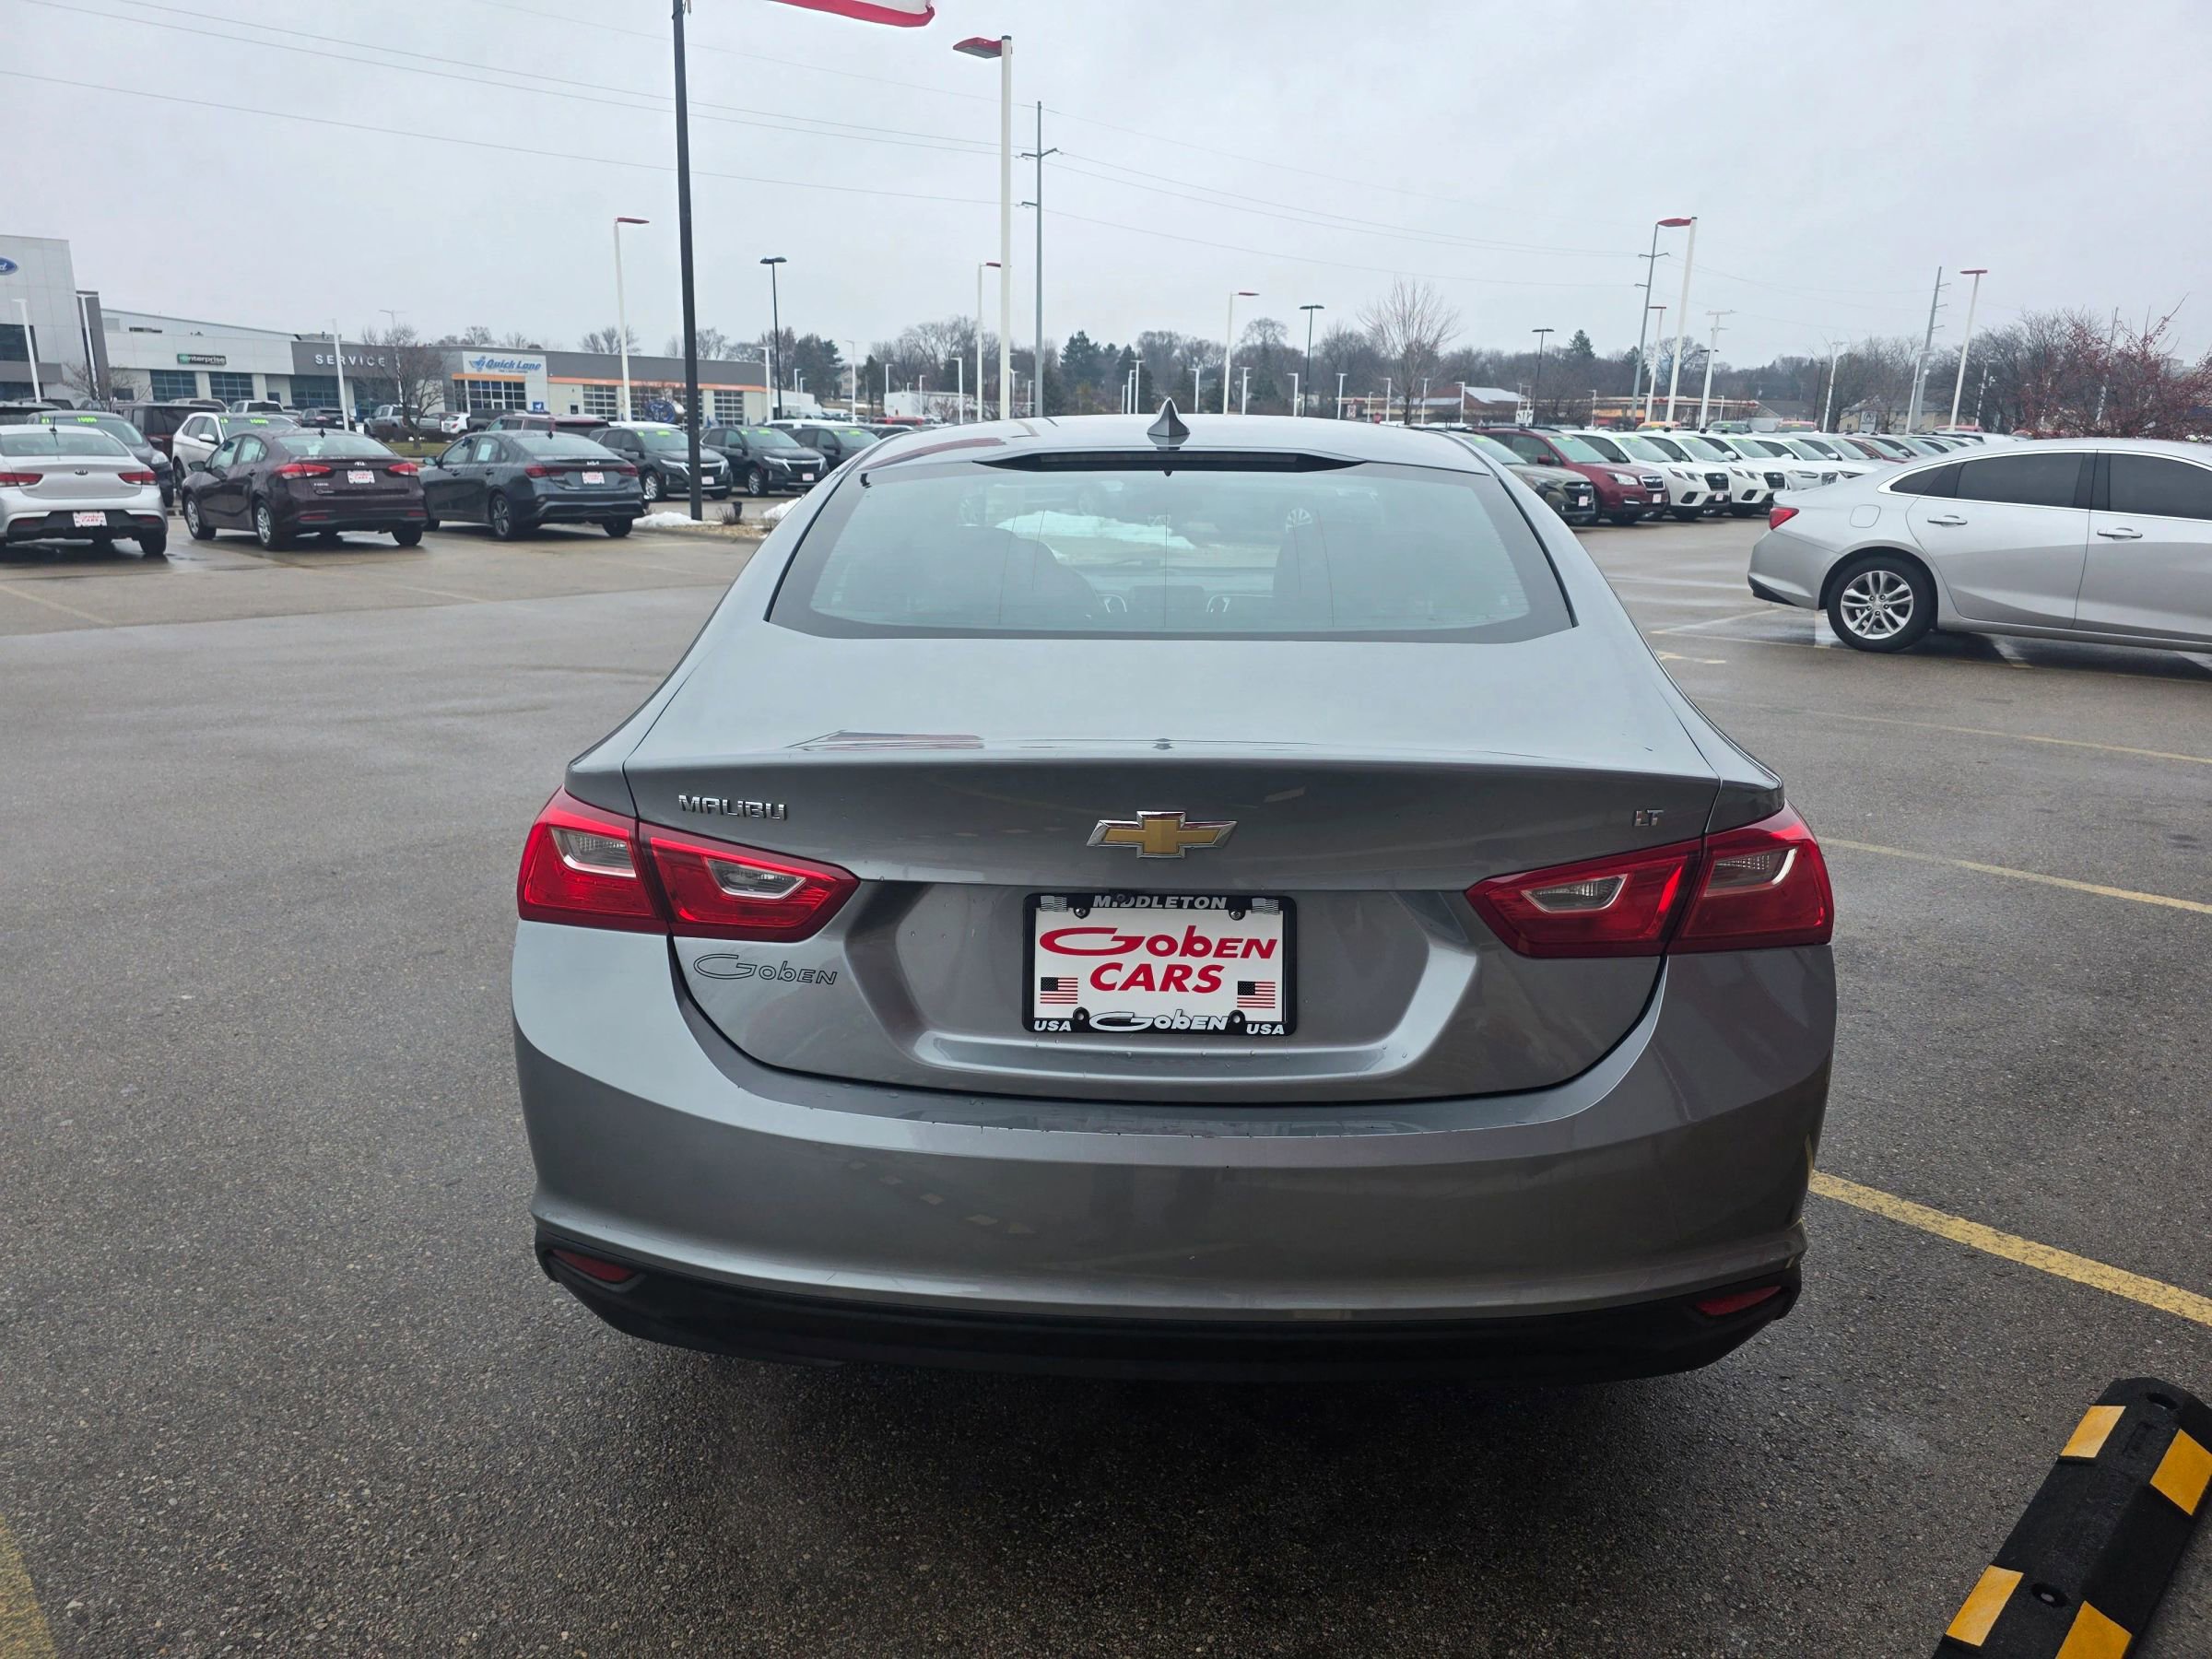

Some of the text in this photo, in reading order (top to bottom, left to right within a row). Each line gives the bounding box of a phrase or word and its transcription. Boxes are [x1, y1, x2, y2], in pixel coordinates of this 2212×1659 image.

[315, 354, 385, 367] SERVICE
[486, 359, 541, 370] Quick Lane
[678, 794, 787, 819] MALIBU
[1633, 809, 1664, 827] LT
[1089, 962, 1225, 994] CARS
[1033, 1020, 1072, 1032] USA
[1246, 1024, 1285, 1035] USA
